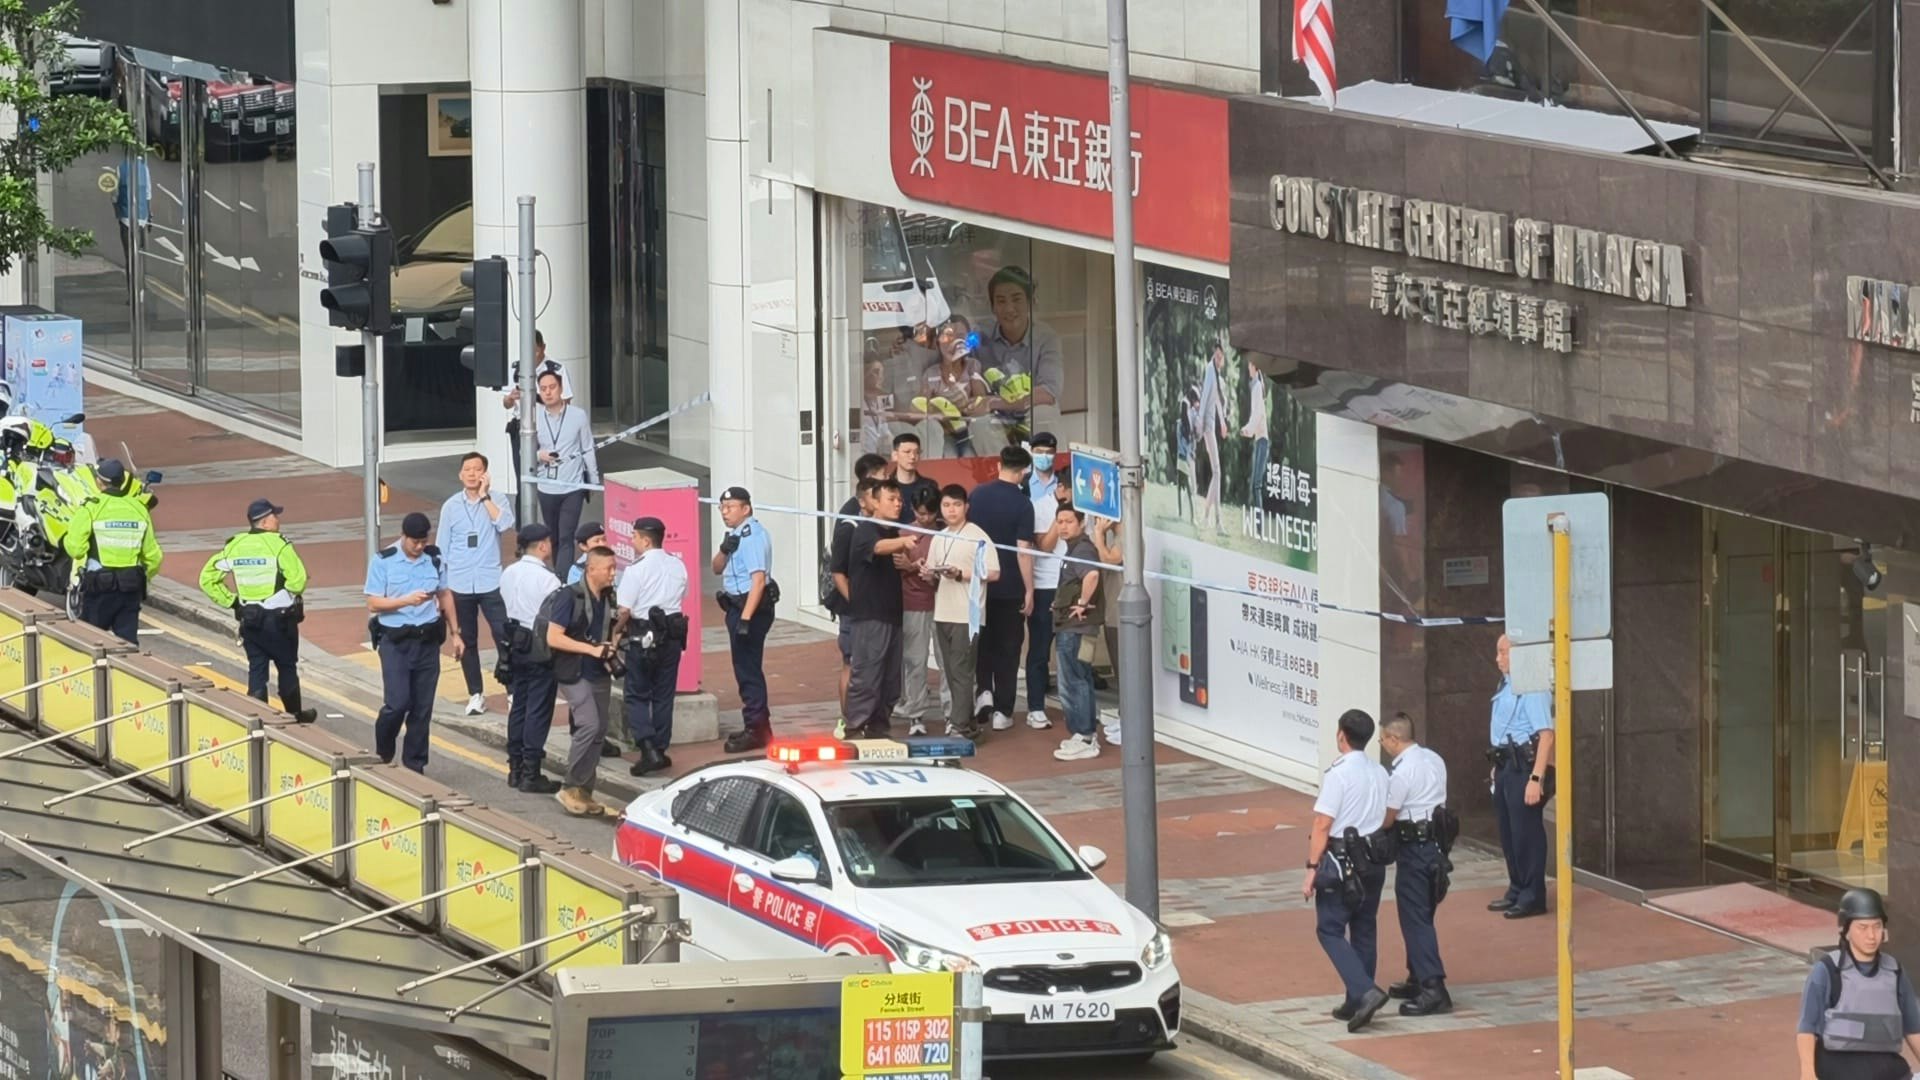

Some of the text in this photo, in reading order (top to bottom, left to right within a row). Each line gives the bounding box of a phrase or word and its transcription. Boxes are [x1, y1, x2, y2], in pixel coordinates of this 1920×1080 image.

[945, 96, 1018, 174] BEA
[1404, 199, 1512, 273] GENERAL
[1514, 217, 1550, 279] OF
[1553, 224, 1688, 307] MALAYSIA
[1155, 282, 1199, 305] BEA 東亞銀行
[871, 747, 895, 759] POLICE
[764, 891, 804, 927] POLICE
[1000, 920, 1093, 935] POLICE
[884, 992, 922, 1006] 分域街
[1029, 1002, 1111, 1020] AM 7620
[591, 1028, 616, 1040] 70P
[866, 1019, 950, 1042] 115 115P 302
[590, 1048, 614, 1060] 722
[866, 1042, 950, 1066] 641 680X 720
